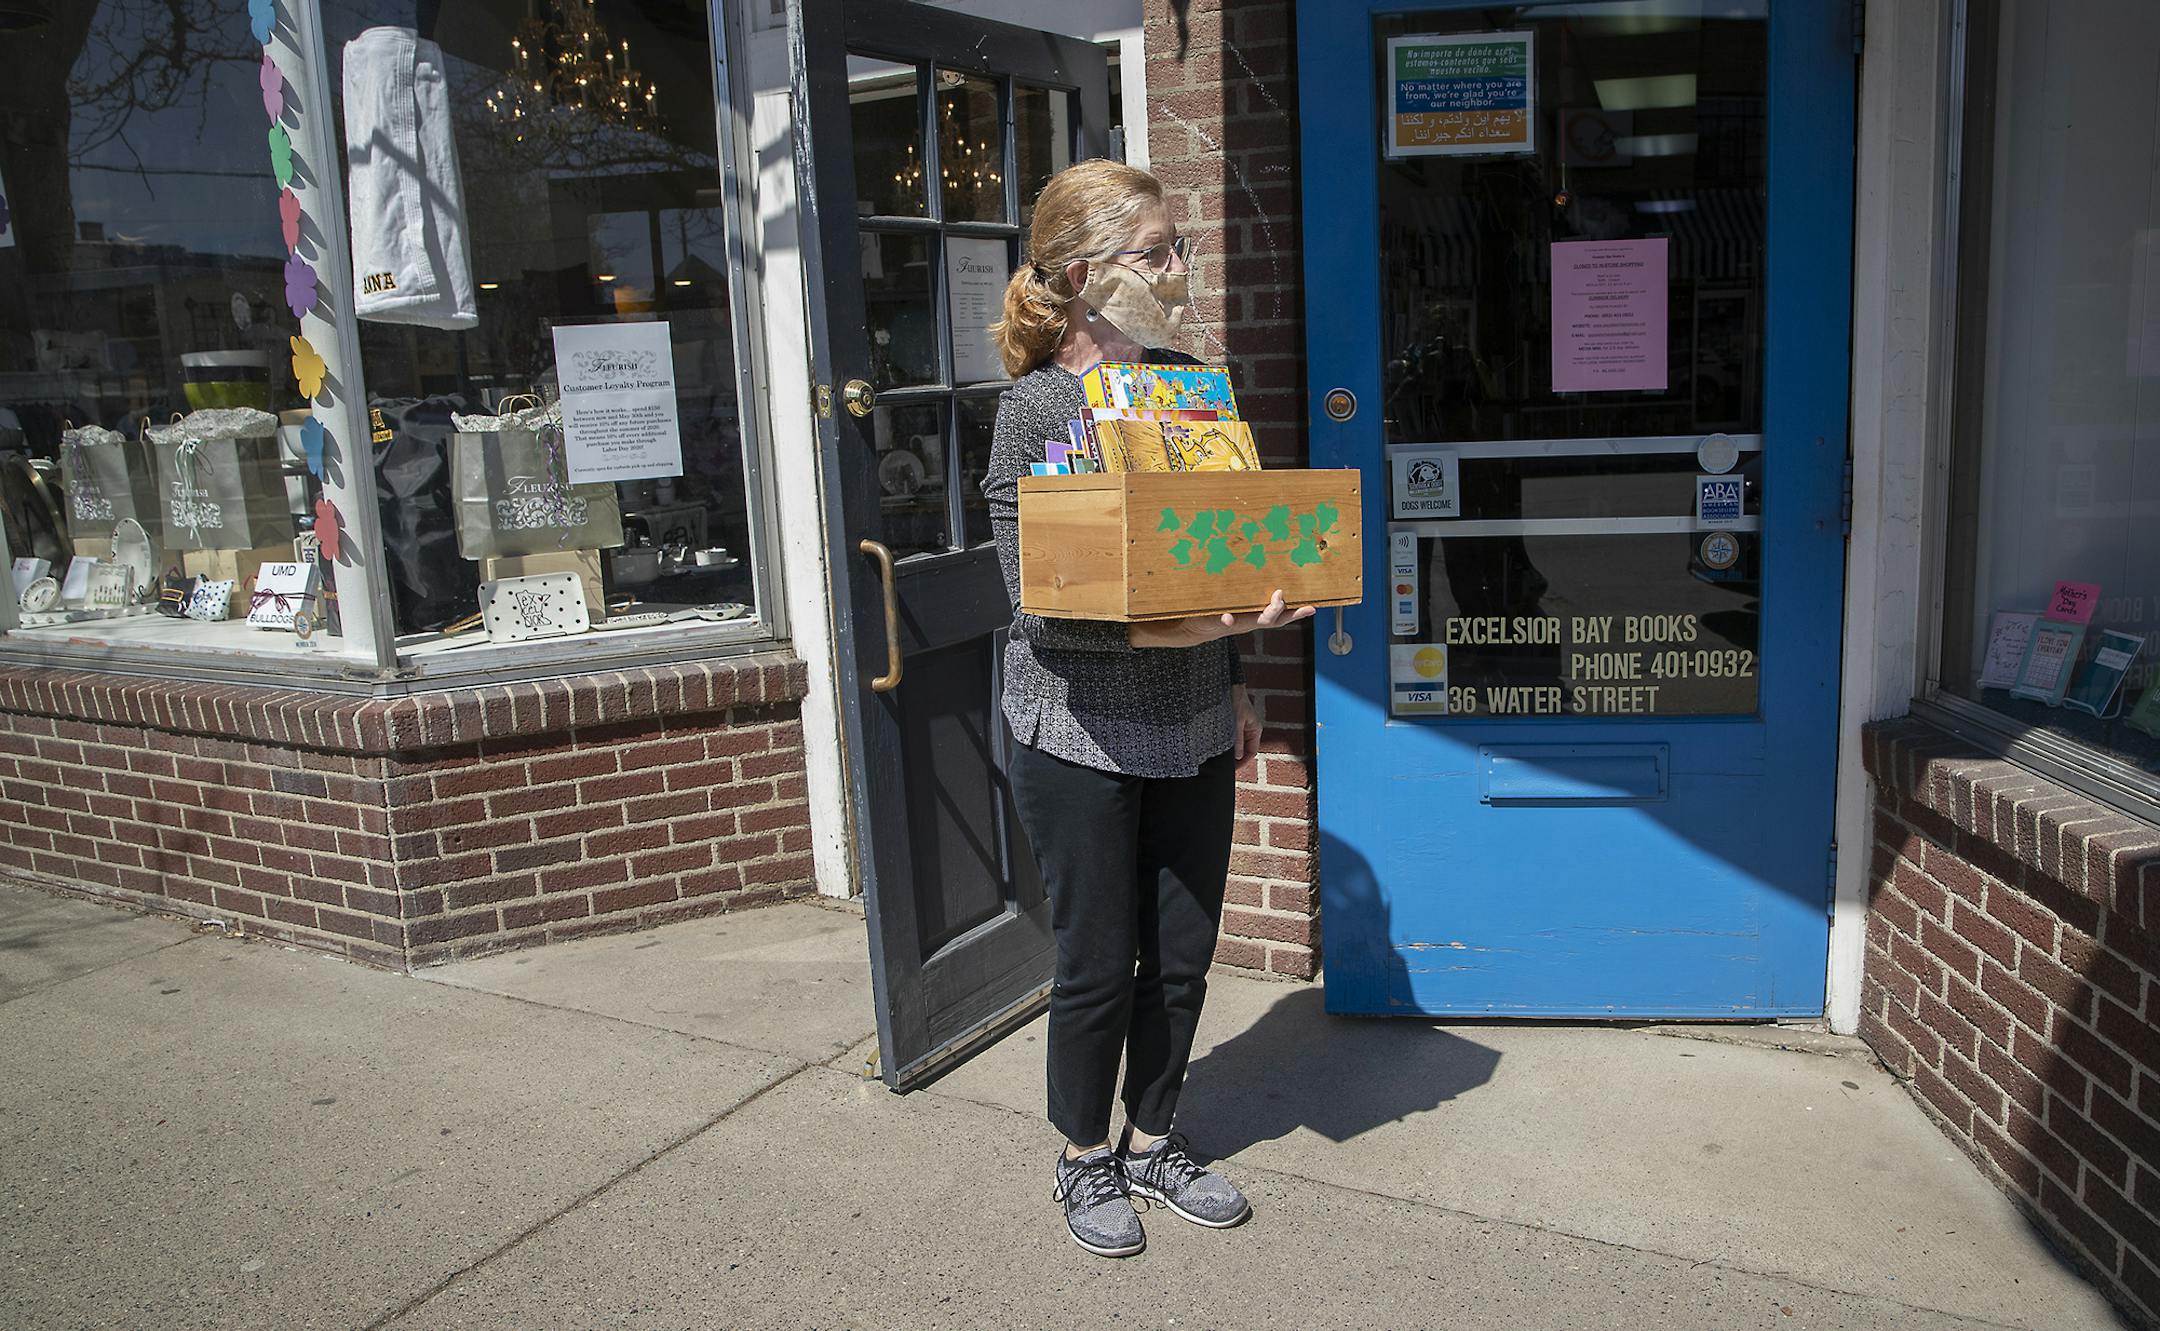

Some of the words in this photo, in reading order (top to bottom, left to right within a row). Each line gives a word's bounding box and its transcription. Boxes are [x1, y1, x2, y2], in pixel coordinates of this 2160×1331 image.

[1407, 50, 1417, 58] No
[1456, 48, 1464, 56] de
[1401, 83, 1414, 92] No
[1418, 82, 1449, 91] matter
[1453, 80, 1482, 89] where
[1406, 92, 1430, 100] from,
[1463, 90, 1484, 100] glad
[1488, 89, 1517, 99] you're
[1450, 98, 1495, 110] neighbor.
[589, 359, 638, 373] FLEURISH
[563, 384, 602, 392] Customer
[605, 382, 634, 391] Loyalty
[637, 380, 670, 389] Program
[1704, 483, 1738, 500] ABA
[1402, 501, 1418, 510] DOGS
[1420, 499, 1451, 509] WELCOME
[272, 566, 296, 576] UMD
[2056, 585, 2087, 600] Mother's
[2063, 598, 2076, 607] Day
[2056, 605, 2077, 615] Cards
[250, 614, 294, 623] BULLDOGS
[1445, 616, 1561, 644] EXCELSIOR
[1572, 616, 1613, 643] BAY
[1624, 614, 1698, 643] BOOKS
[1571, 652, 1641, 680] PHONE
[1650, 650, 1753, 679] 401-0932
[1408, 692, 1432, 702] VISA
[1449, 686, 1476, 713] 36
[1487, 686, 1562, 713] WATER
[1573, 686, 1659, 713] STREET
